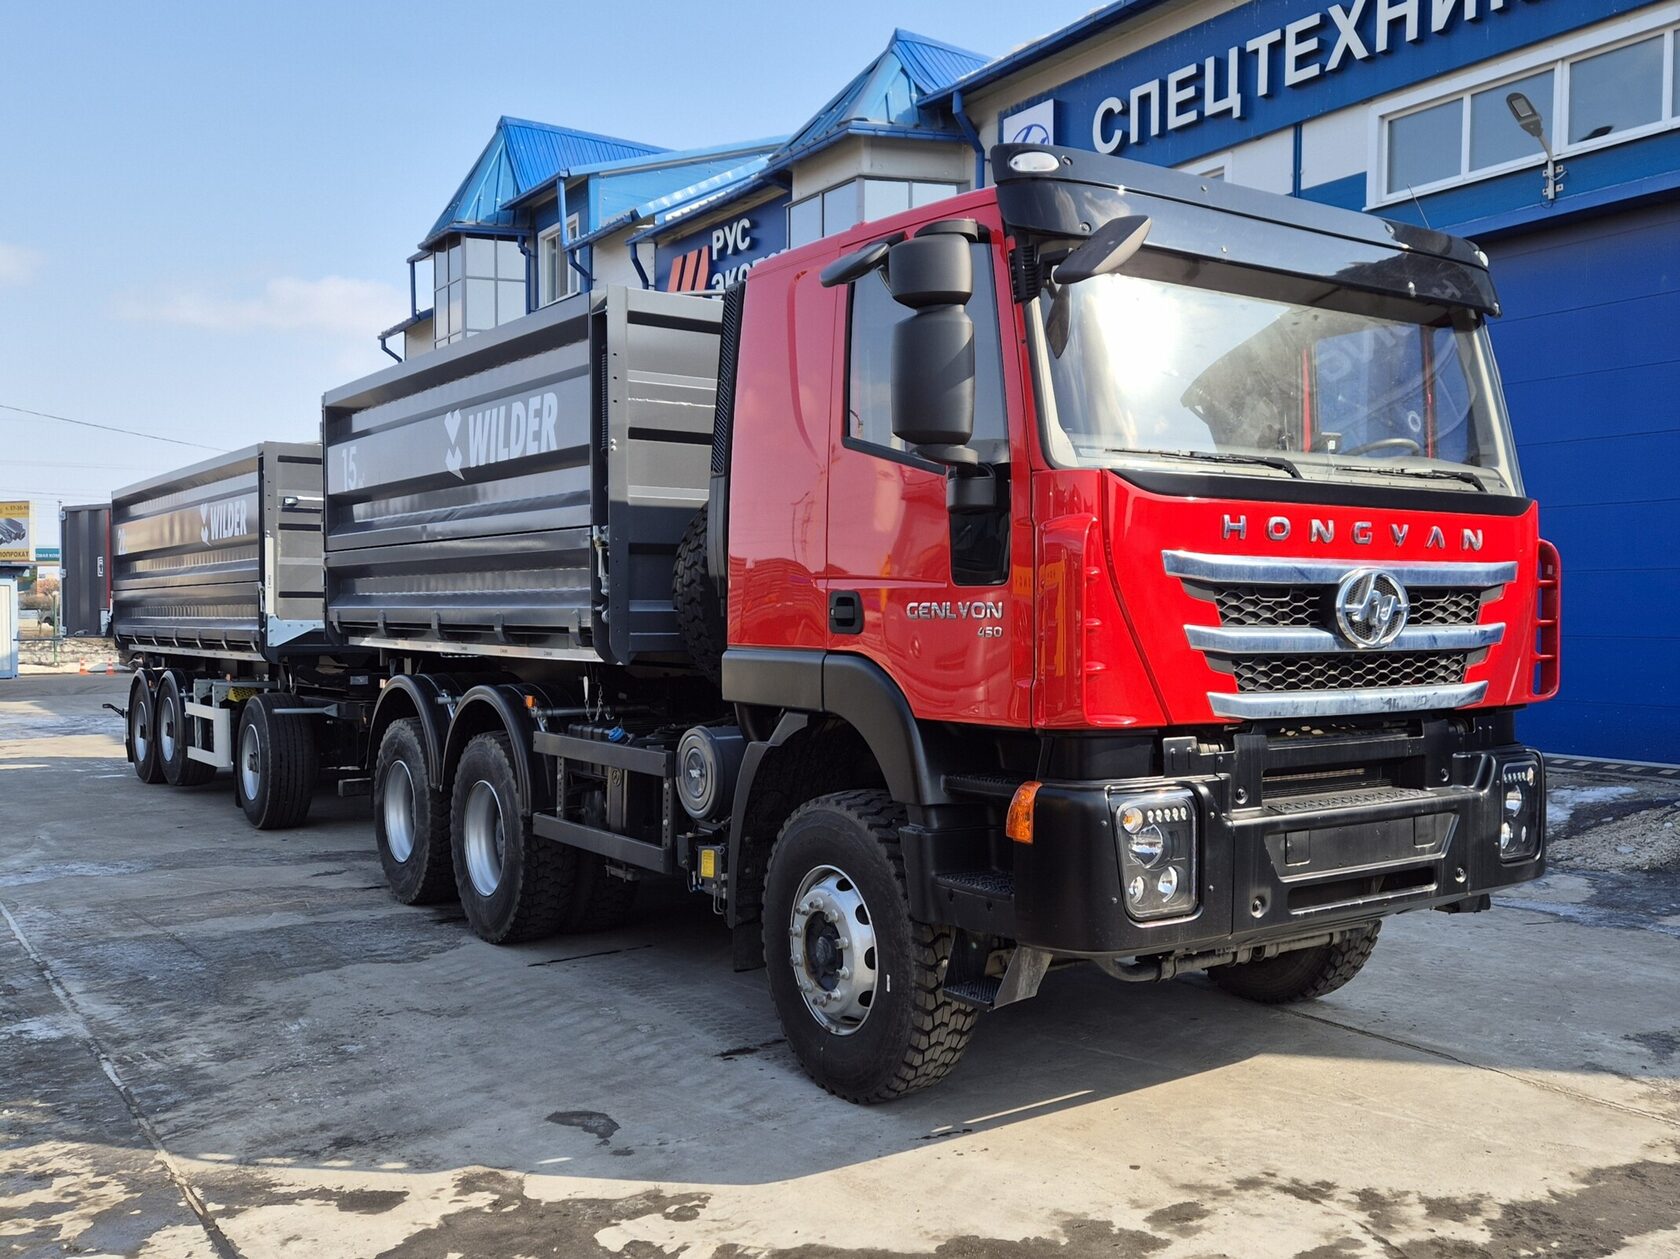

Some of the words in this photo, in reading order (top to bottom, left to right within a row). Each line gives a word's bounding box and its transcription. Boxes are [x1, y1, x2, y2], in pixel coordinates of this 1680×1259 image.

[1093, 0, 1504, 153] СПЕЦТЕХН
[712, 218, 750, 260] РУС
[468, 392, 558, 468] WILDER
[342, 446, 357, 492] 15
[210, 500, 247, 540] WILDER
[1222, 514, 1484, 551] HONGYAN
[906, 601, 1003, 619] GENLYON
[977, 626, 1003, 638] 450
